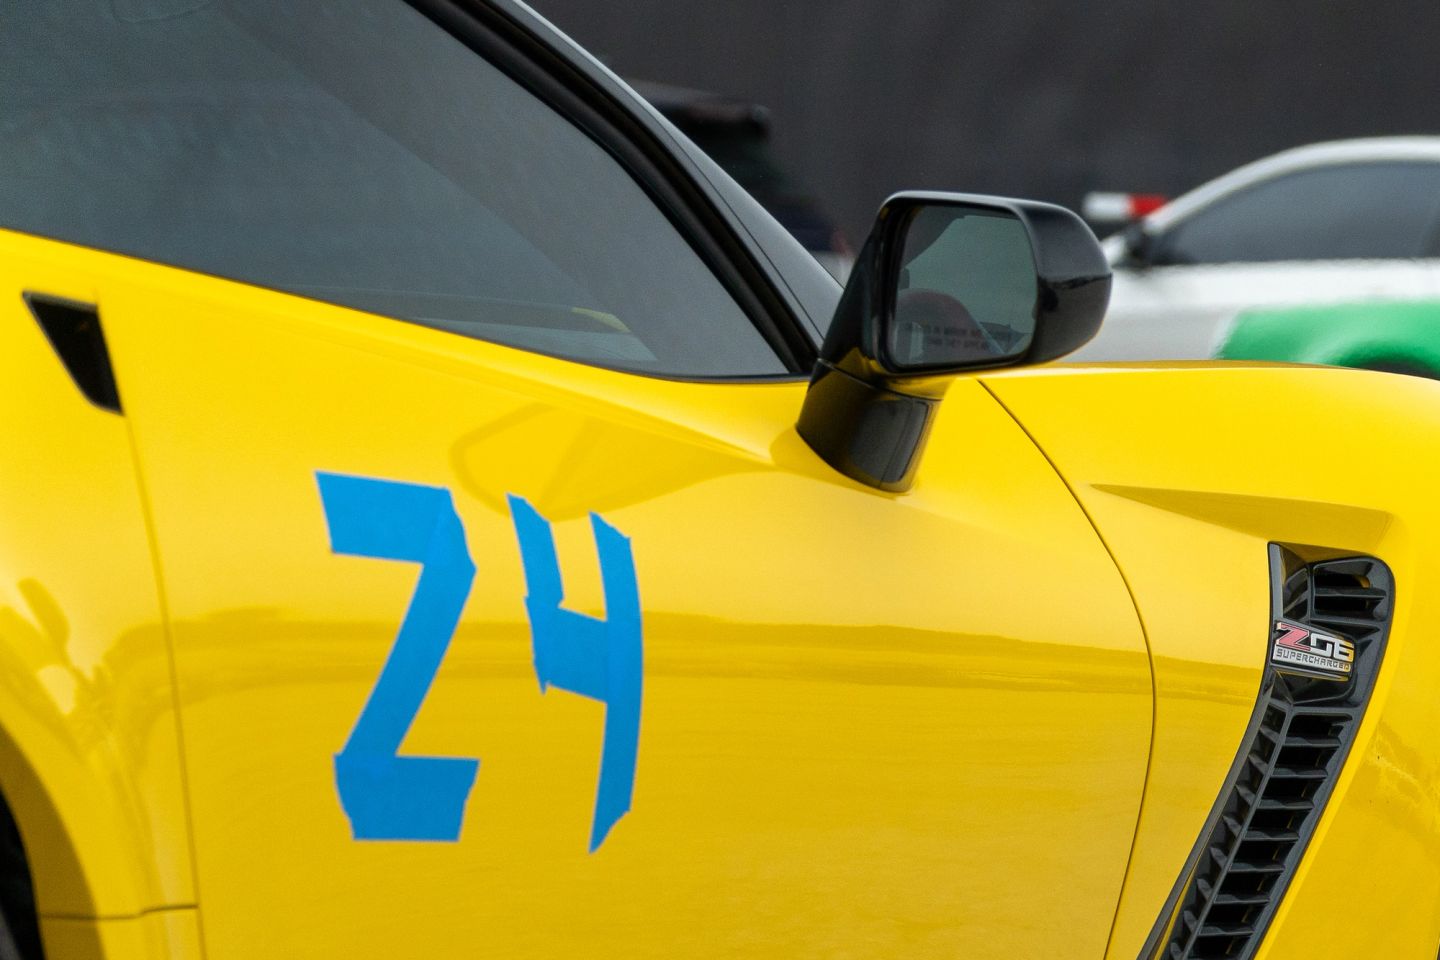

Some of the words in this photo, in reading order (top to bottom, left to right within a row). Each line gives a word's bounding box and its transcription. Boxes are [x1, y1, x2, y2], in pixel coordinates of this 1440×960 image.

[313, 470, 644, 855] 24
[1275, 621, 1355, 663] Z06
[1275, 647, 1352, 672] SUPERCHARGED
